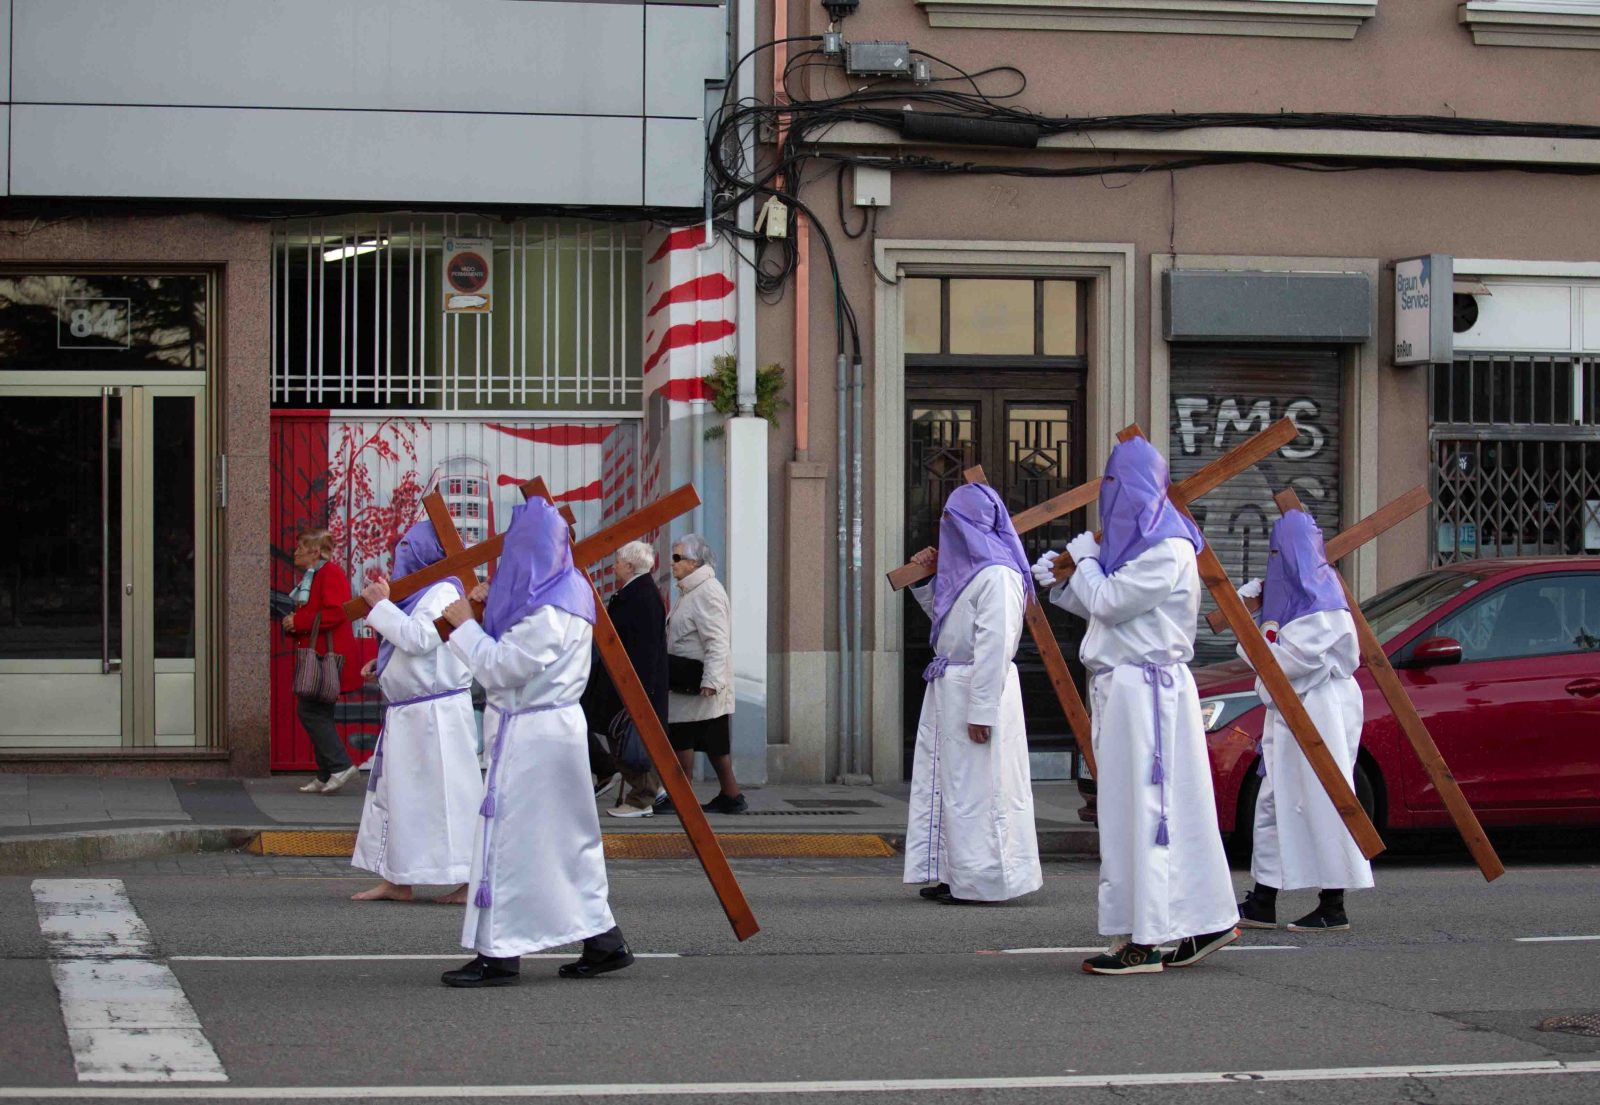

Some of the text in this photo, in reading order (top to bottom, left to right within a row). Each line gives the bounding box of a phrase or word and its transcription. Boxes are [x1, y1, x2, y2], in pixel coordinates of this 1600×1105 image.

[1397, 274, 1418, 292] Braun
[1402, 291, 1429, 310] Service
[70, 309, 116, 338] 84
